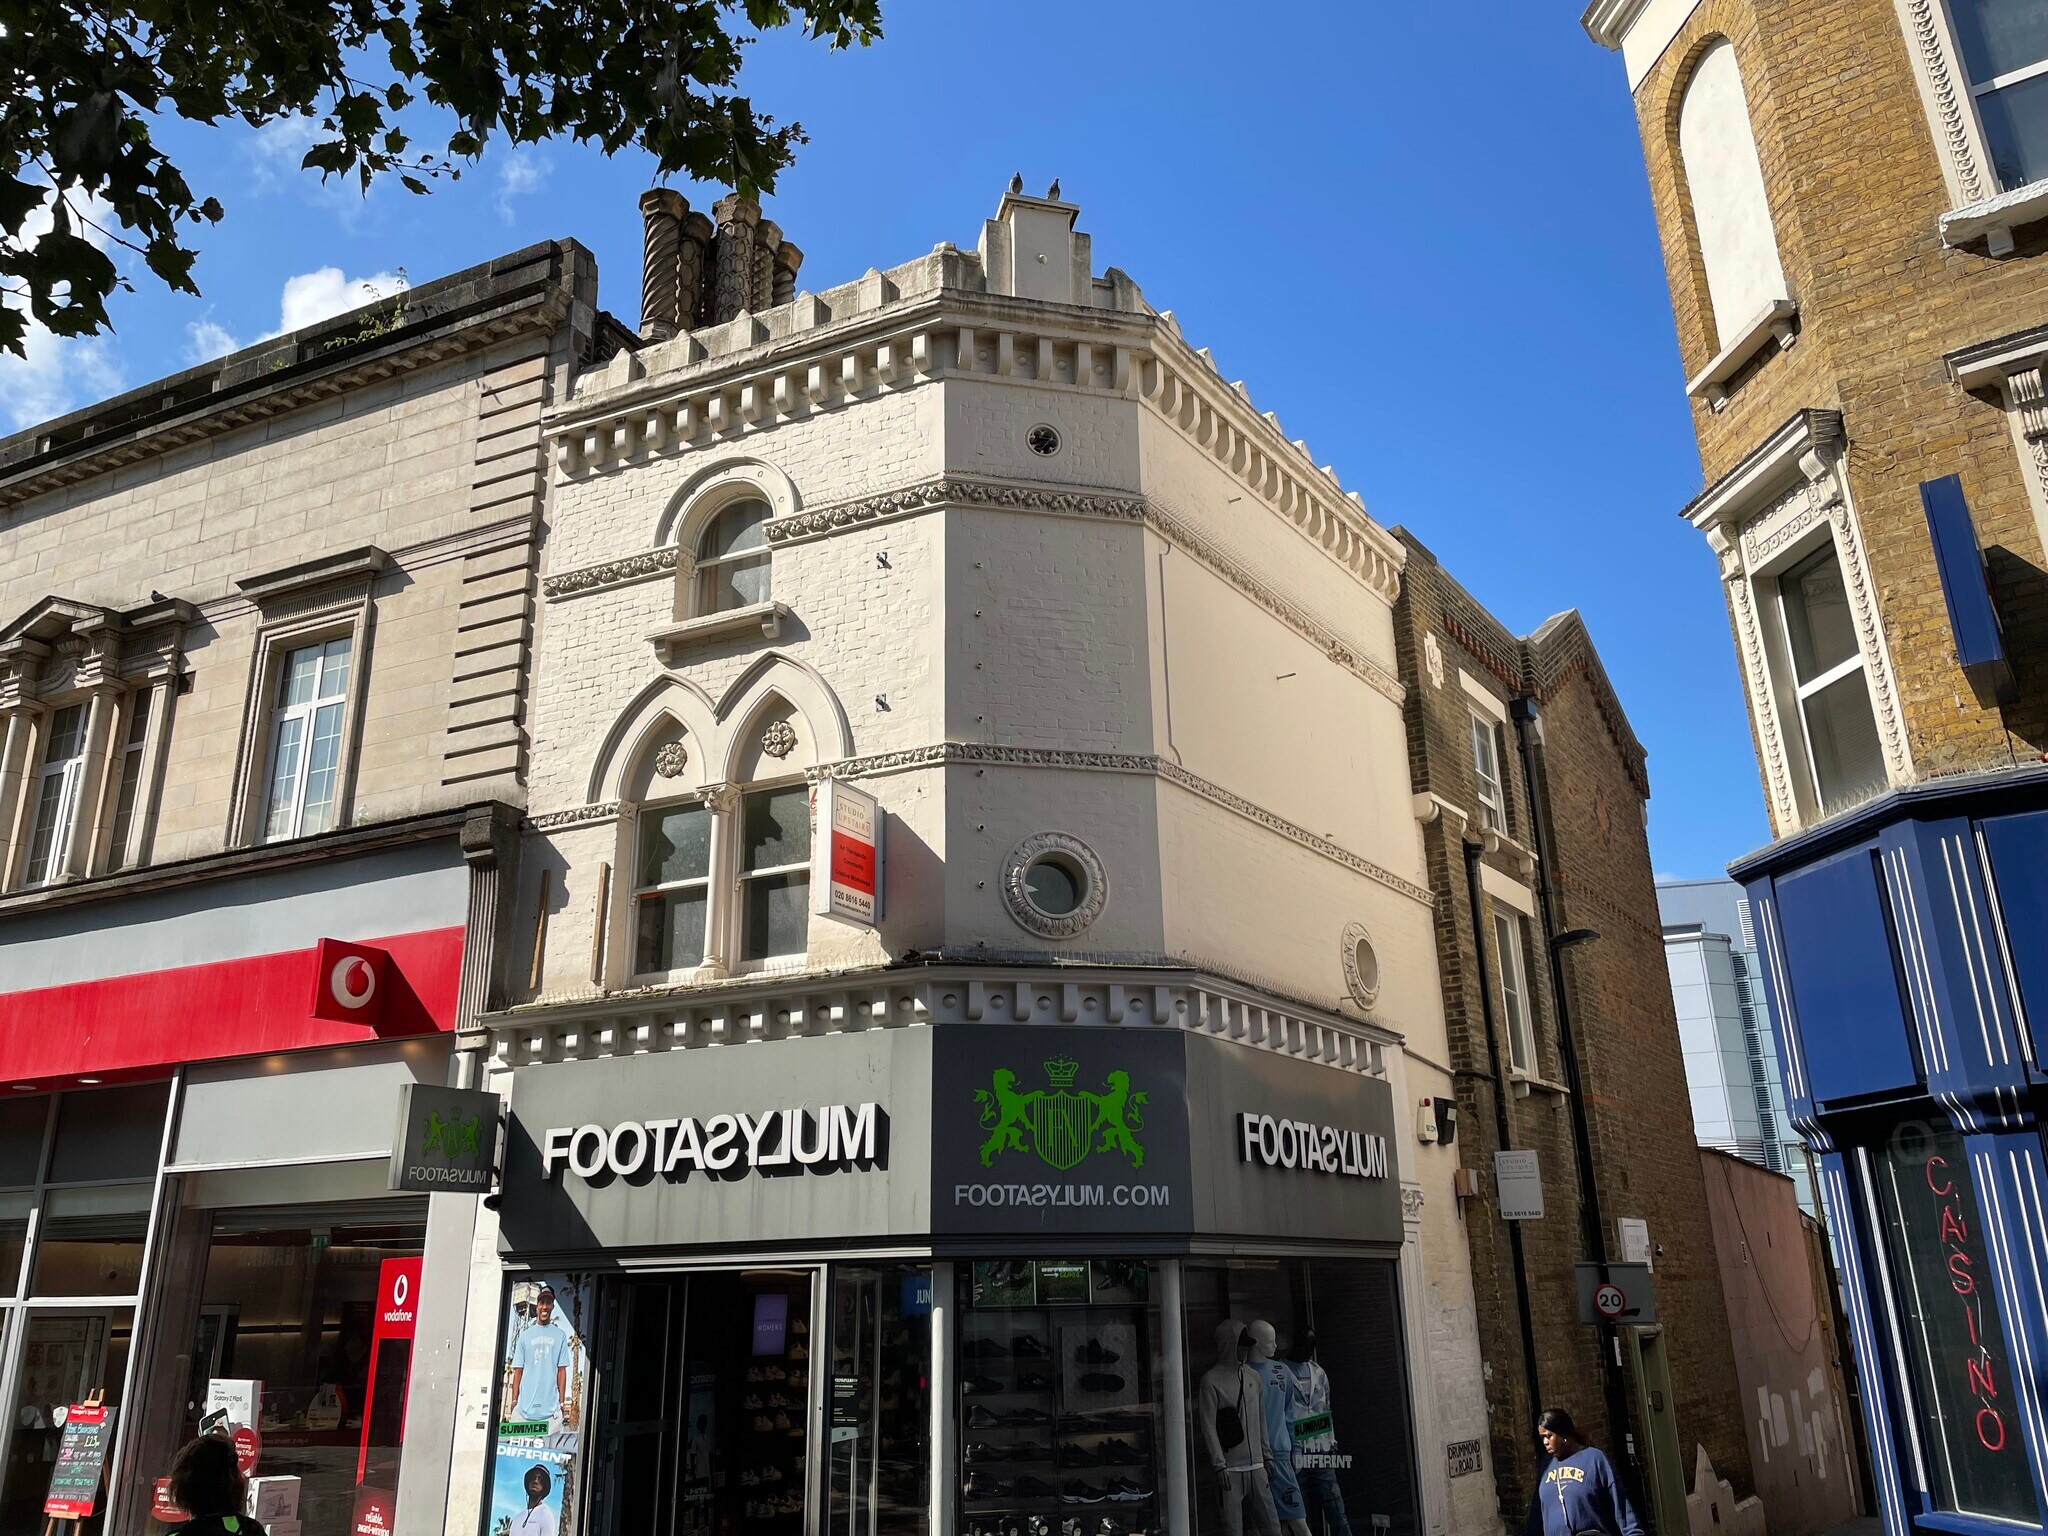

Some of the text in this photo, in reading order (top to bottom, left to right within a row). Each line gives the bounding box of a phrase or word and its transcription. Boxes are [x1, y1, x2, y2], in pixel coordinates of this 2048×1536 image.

[840, 803, 865, 820] STUDIO
[838, 813, 870, 833] UPSTAIRS
[835, 889, 871, 910] 020 8616 5440
[542, 1103, 876, 1179] FOOTASYLUM
[1242, 1112, 1389, 1180] FOOTASYLUM
[408, 1166, 487, 1184] FOOTASYLUM
[954, 1184, 1170, 1206] FOOTASYLUM.COM
[1600, 1294, 1622, 1307] 20
[1926, 1156, 2006, 1451] CASINO
[384, 1311, 412, 1322] vodafone
[500, 1423, 548, 1434] SUMMER
[1294, 1415, 1332, 1437] SUMMER
[509, 1437, 544, 1448] HITS
[1449, 1440, 1480, 1460] DRUMMOND
[497, 1445, 572, 1464] DIFFERENT
[1295, 1454, 1353, 1469] DIFFERENT
[1459, 1457, 1473, 1473] ROAD
[1545, 1466, 1584, 1484] NIKE
